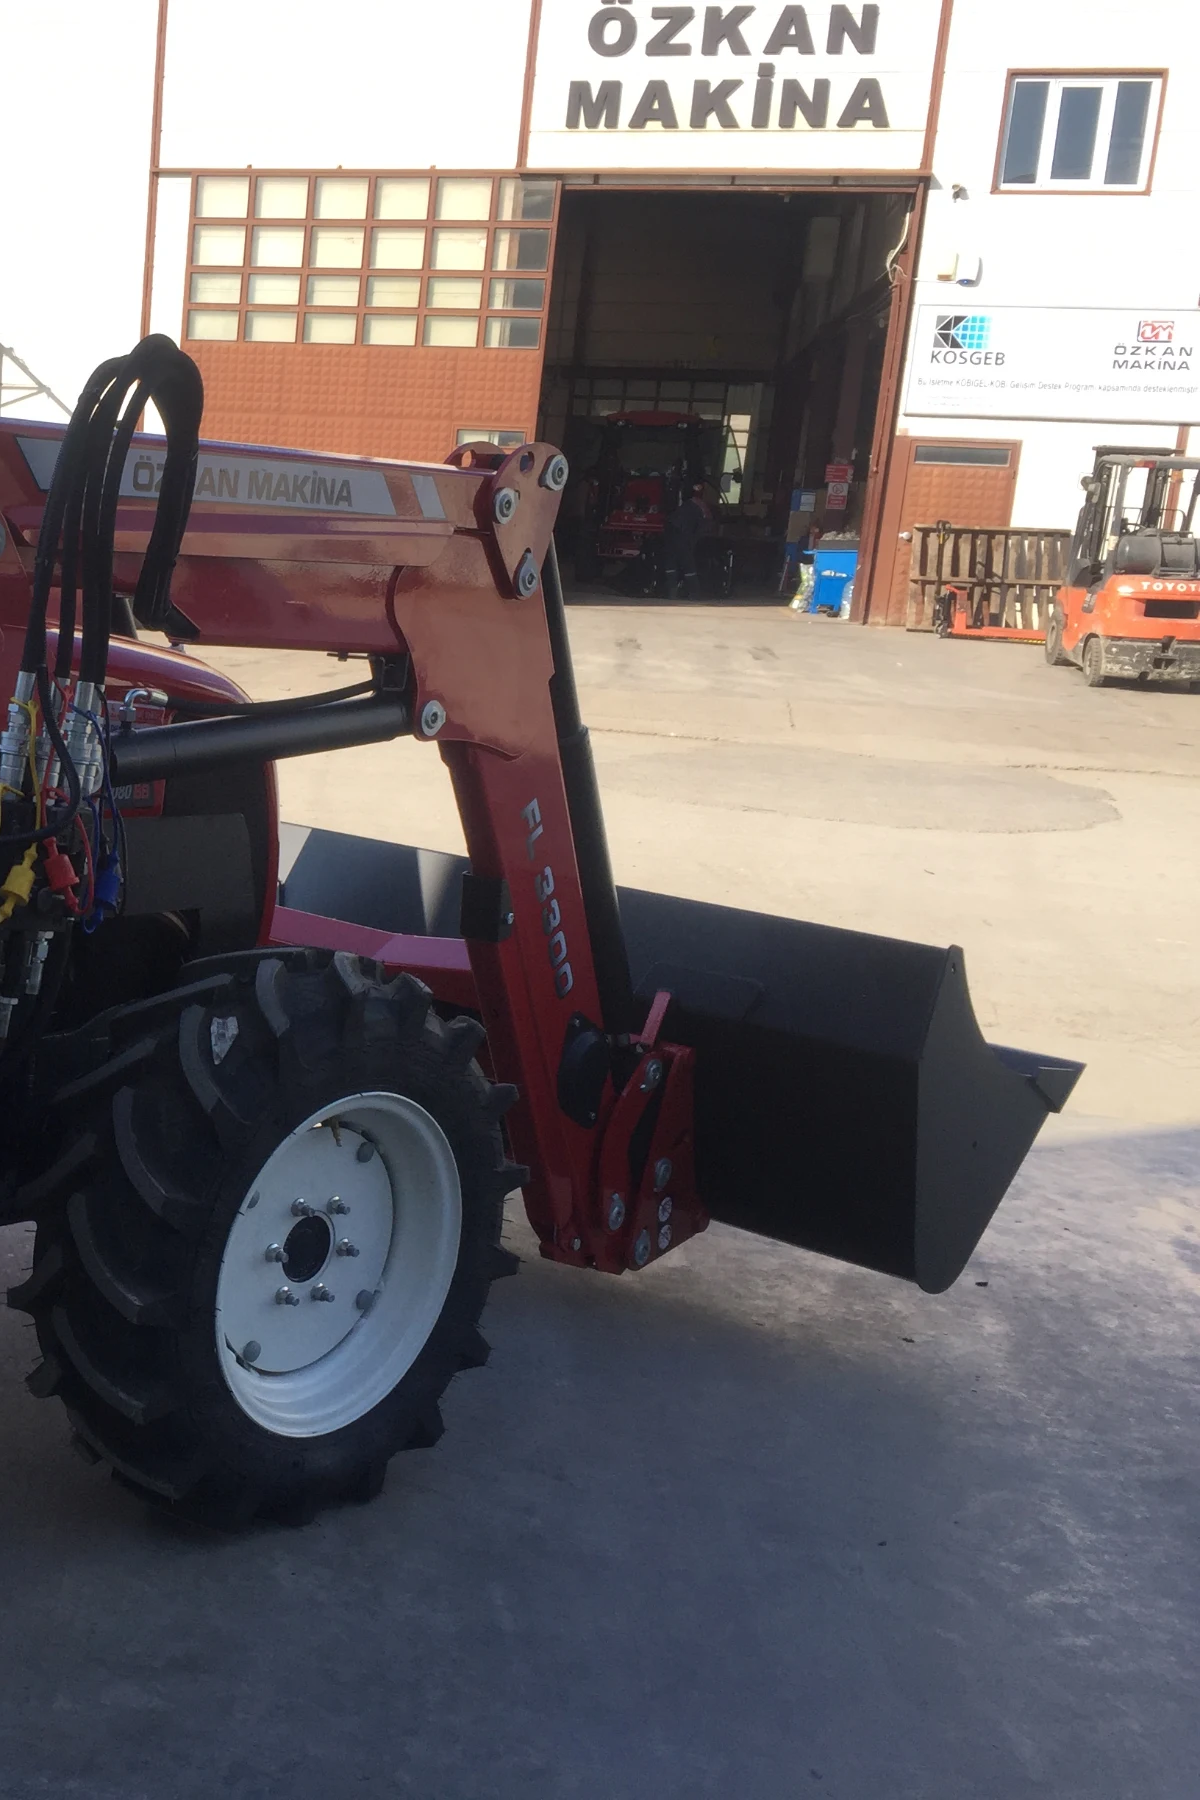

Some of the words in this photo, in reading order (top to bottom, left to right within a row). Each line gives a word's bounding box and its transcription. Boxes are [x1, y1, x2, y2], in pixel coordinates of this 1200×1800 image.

[588, 0, 880, 57] ÖZKAN
[565, 62, 890, 129] MAKİNA
[930, 350, 1005, 366] KOSGEB
[1113, 342, 1194, 357] ÖZKAN
[1112, 357, 1191, 371] MAKİNA
[247, 469, 353, 507] MAKİNA
[1141, 581, 1200, 592] TOYOT
[520, 798, 544, 862] FL
[534, 866, 574, 999] 3300
